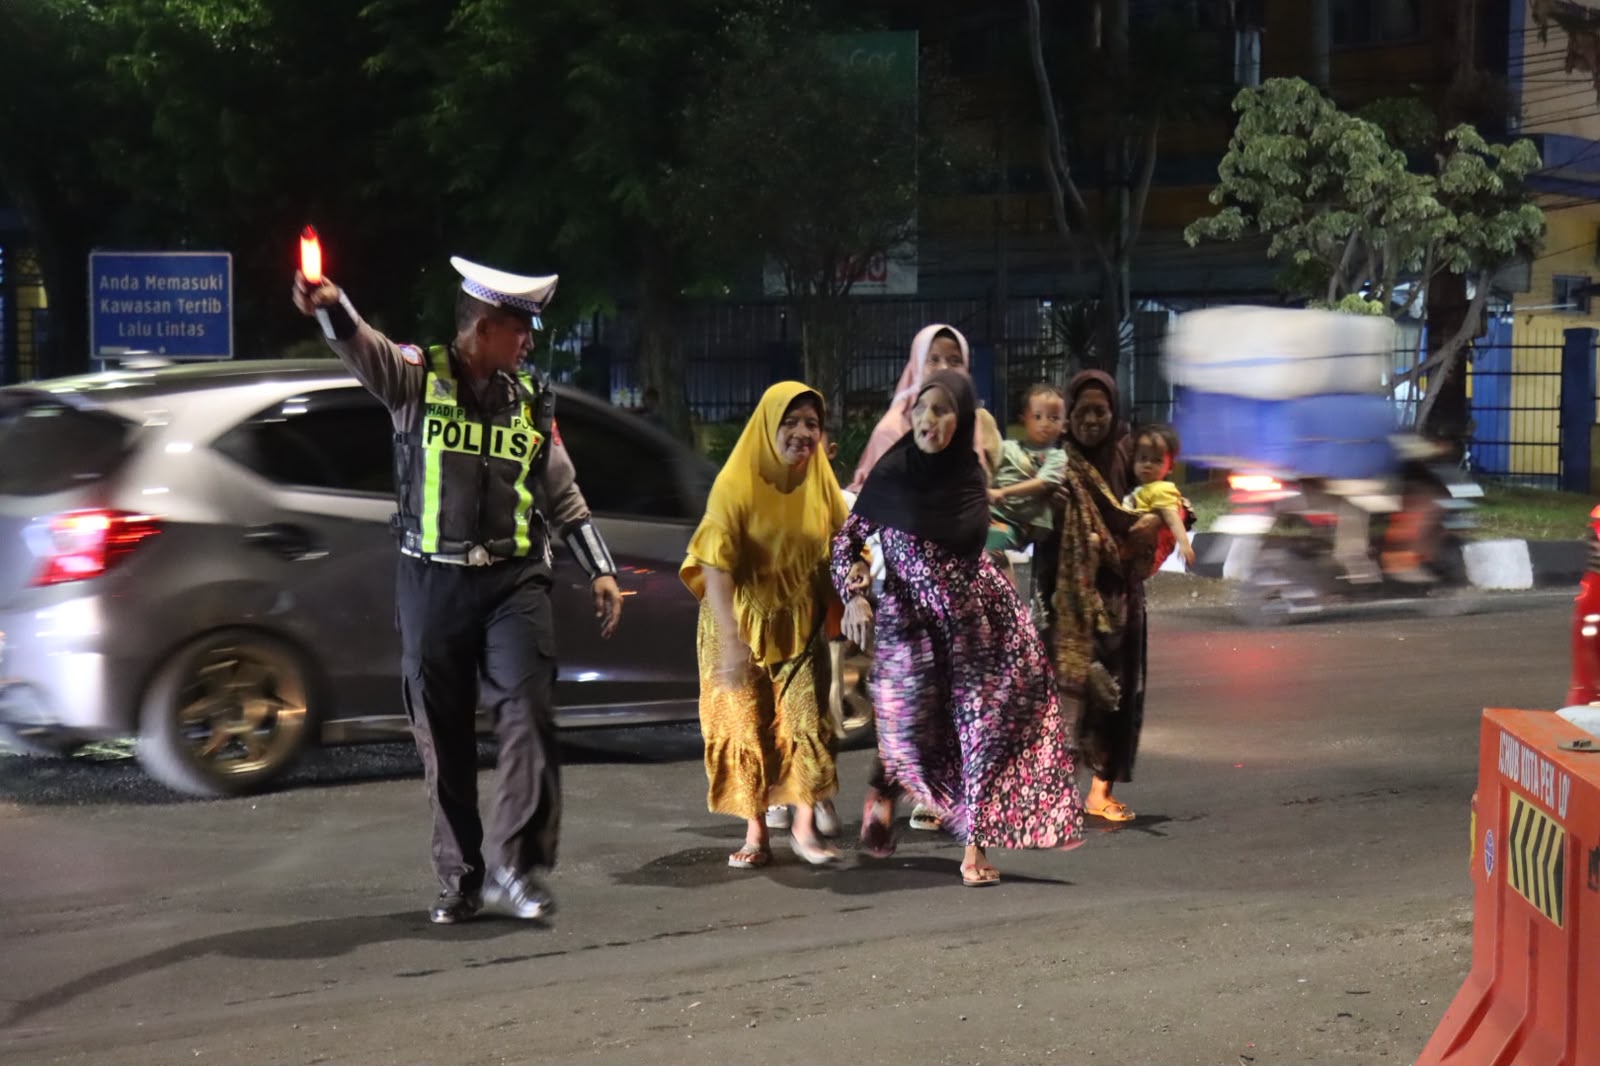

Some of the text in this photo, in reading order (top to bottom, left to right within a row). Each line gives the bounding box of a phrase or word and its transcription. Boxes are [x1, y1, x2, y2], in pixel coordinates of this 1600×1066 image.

[100, 274, 223, 290] Anda Memasuki
[100, 298, 222, 314] Kawasan Tertib
[118, 321, 205, 337] Lalu Lintas
[428, 405, 455, 418] HADI
[1520, 745, 1540, 798] KOTA
